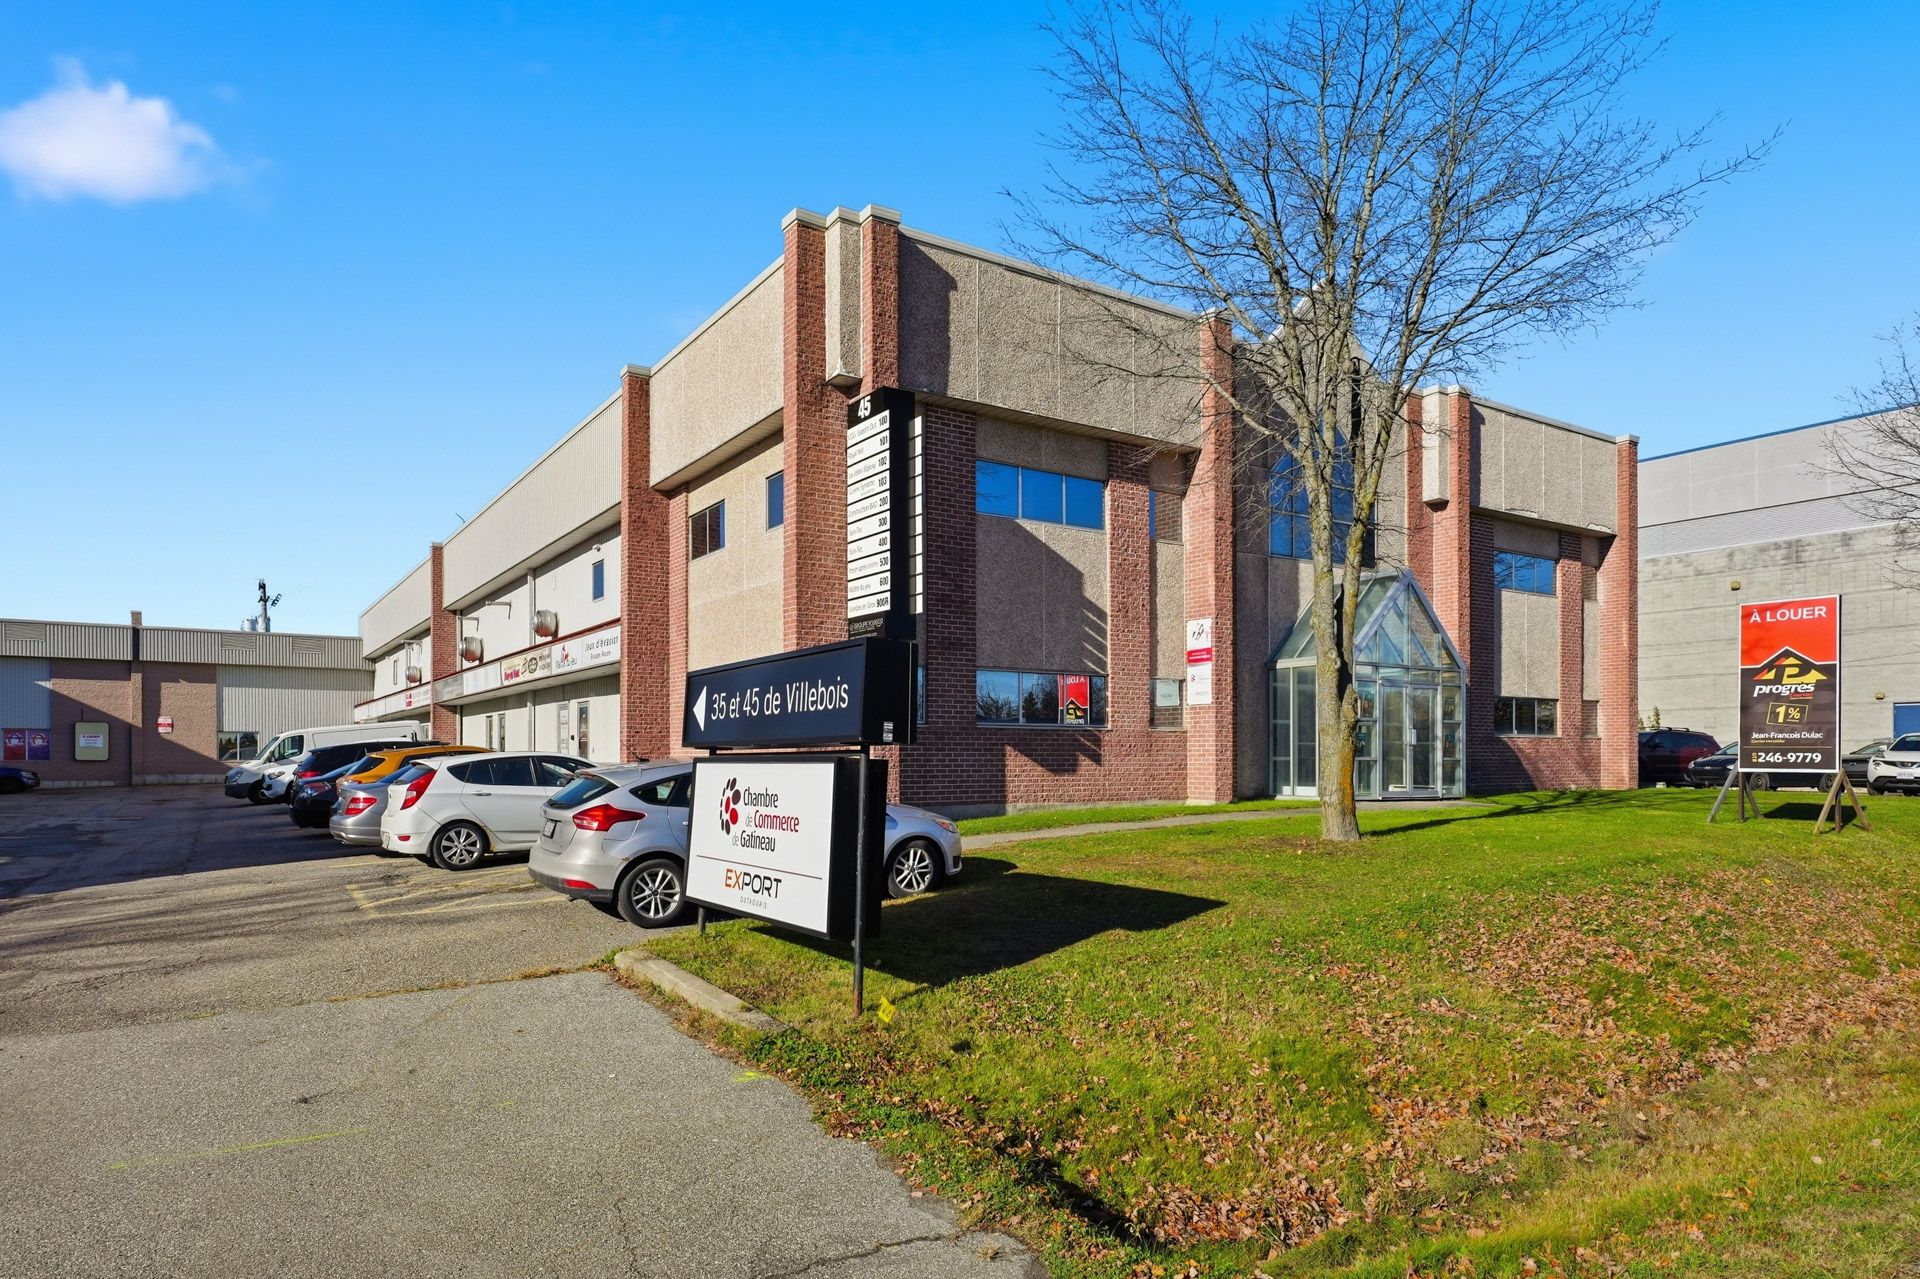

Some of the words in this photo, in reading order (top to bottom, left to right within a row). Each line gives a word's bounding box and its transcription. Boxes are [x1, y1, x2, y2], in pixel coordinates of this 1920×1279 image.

[858, 396, 871, 418] 45
[879, 416, 888, 427] 100
[878, 456, 887, 468] 102
[878, 476, 887, 487] 103
[879, 496, 888, 507] 200
[878, 516, 887, 527] 300
[878, 536, 888, 547] 400
[880, 556, 888, 567] 500
[880, 576, 888, 586] 600
[1750, 608, 1761, 624] À
[1766, 606, 1827, 623] LOUER
[1753, 682, 1816, 698] progrès
[711, 692, 726, 720] 35
[729, 693, 740, 718] et
[743, 687, 760, 716] 45
[764, 686, 781, 715] de
[786, 676, 849, 714] Villebois
[1758, 752, 1822, 763] 246-9779
[743, 787, 779, 808] Chambre
[746, 814, 753, 827] de
[754, 810, 800, 833] Commerce
[732, 834, 739, 847] de
[740, 829, 776, 853] Gatineau
[725, 868, 782, 900] EXPORT
